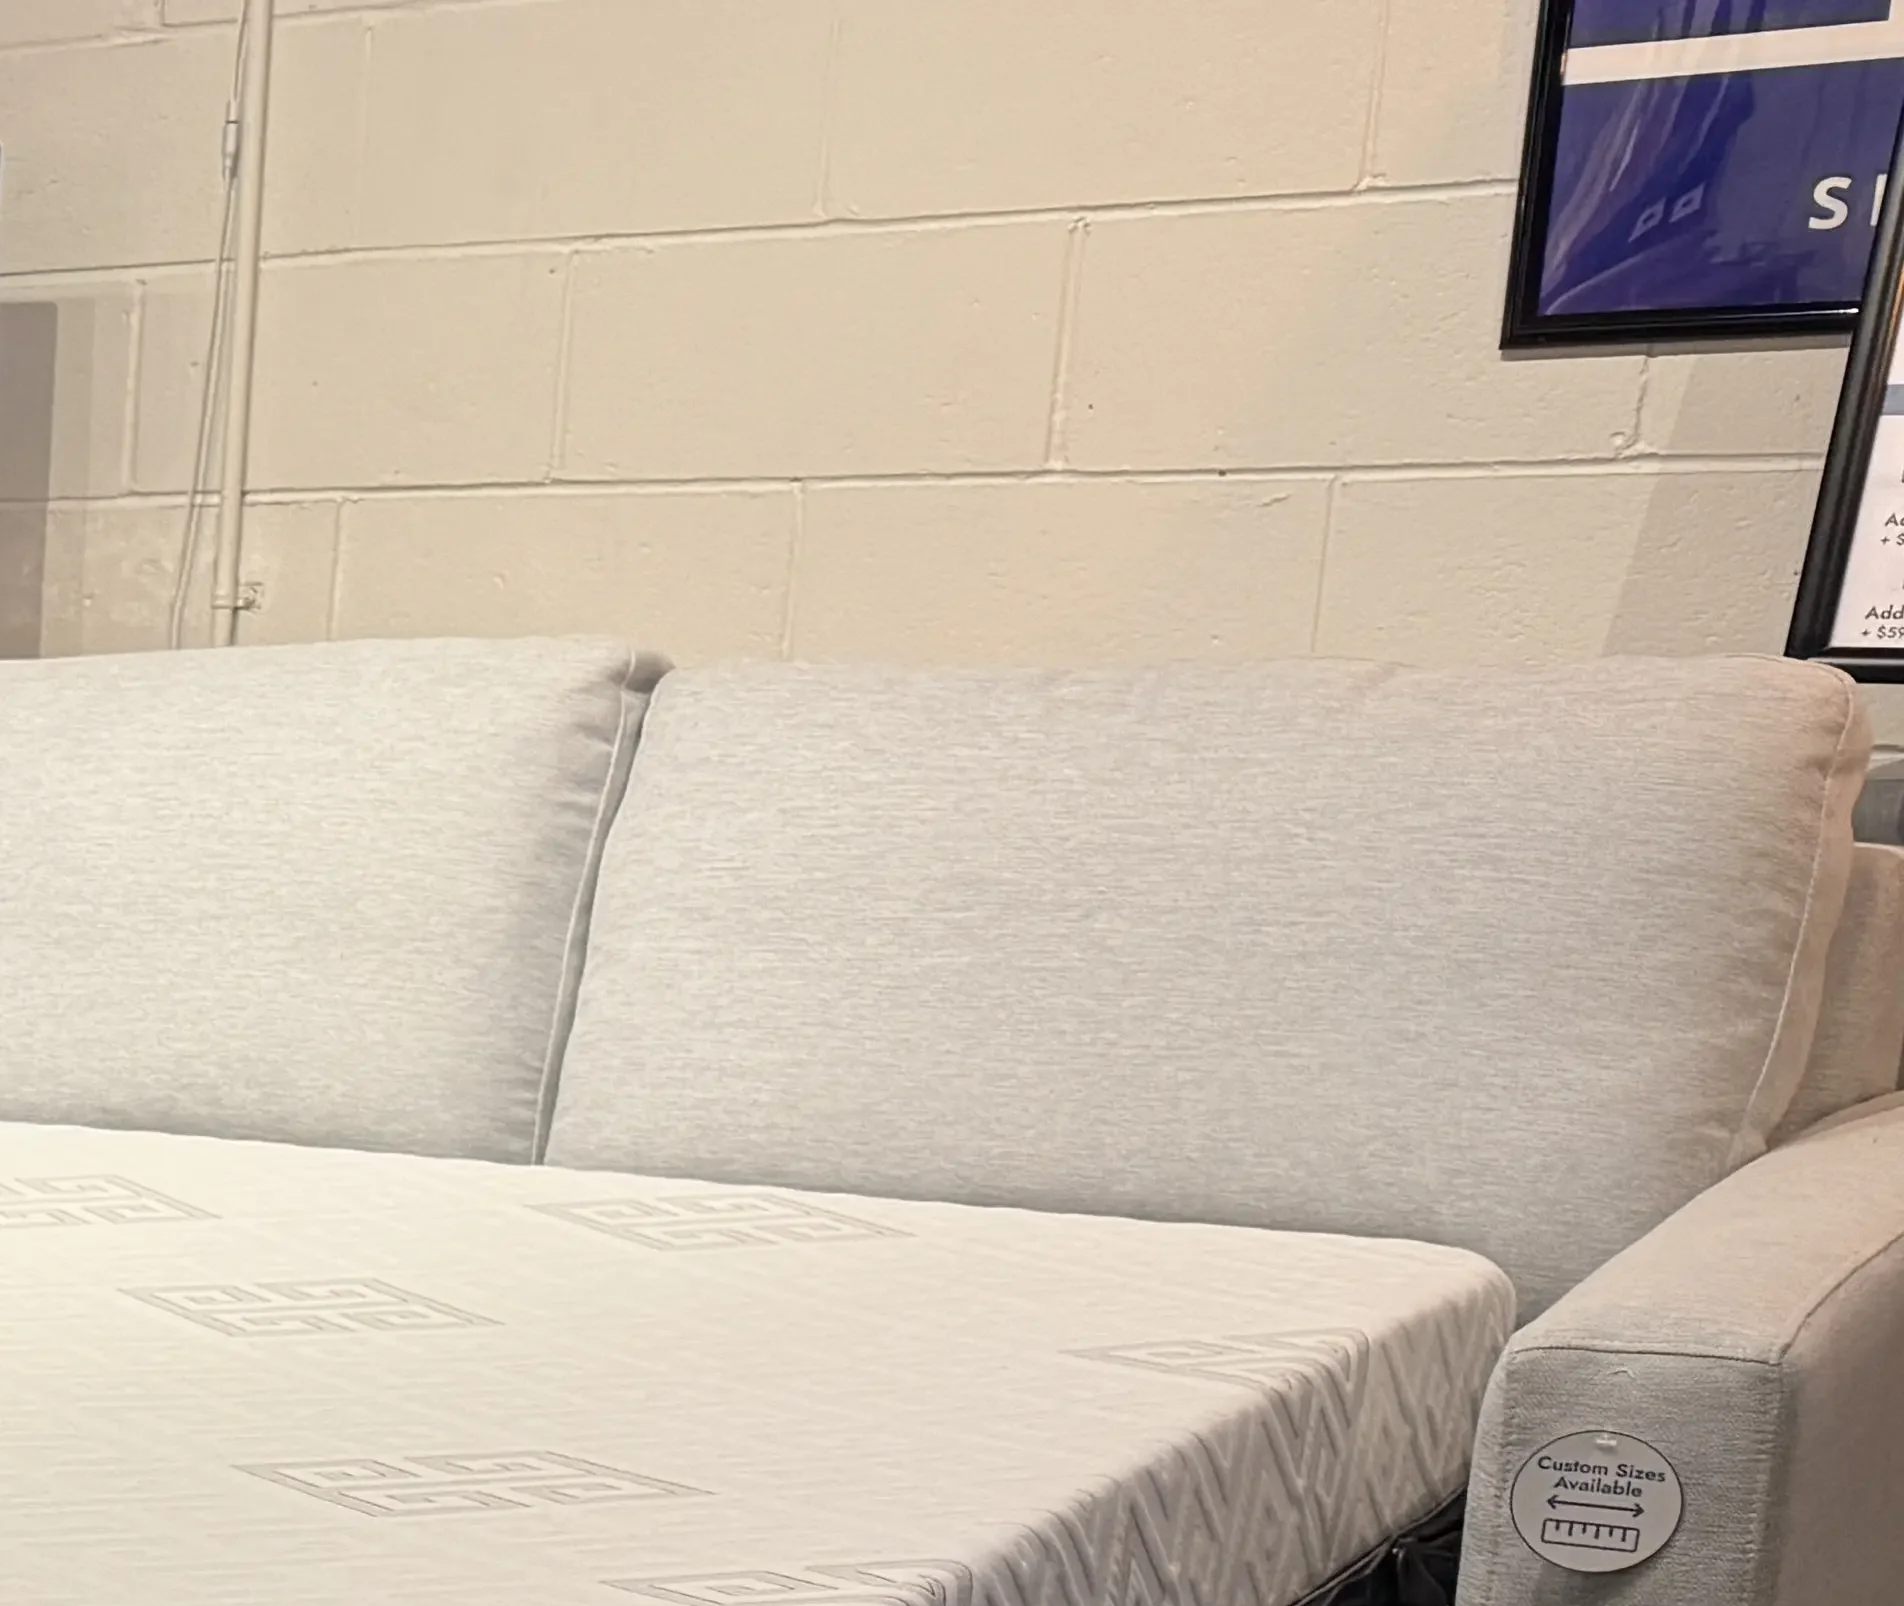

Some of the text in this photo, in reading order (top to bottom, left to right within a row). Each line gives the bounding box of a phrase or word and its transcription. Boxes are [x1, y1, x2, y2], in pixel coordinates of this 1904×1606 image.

[1537, 1455, 1666, 1483] Custom Sizes
[1553, 1476, 1643, 1498] Available
